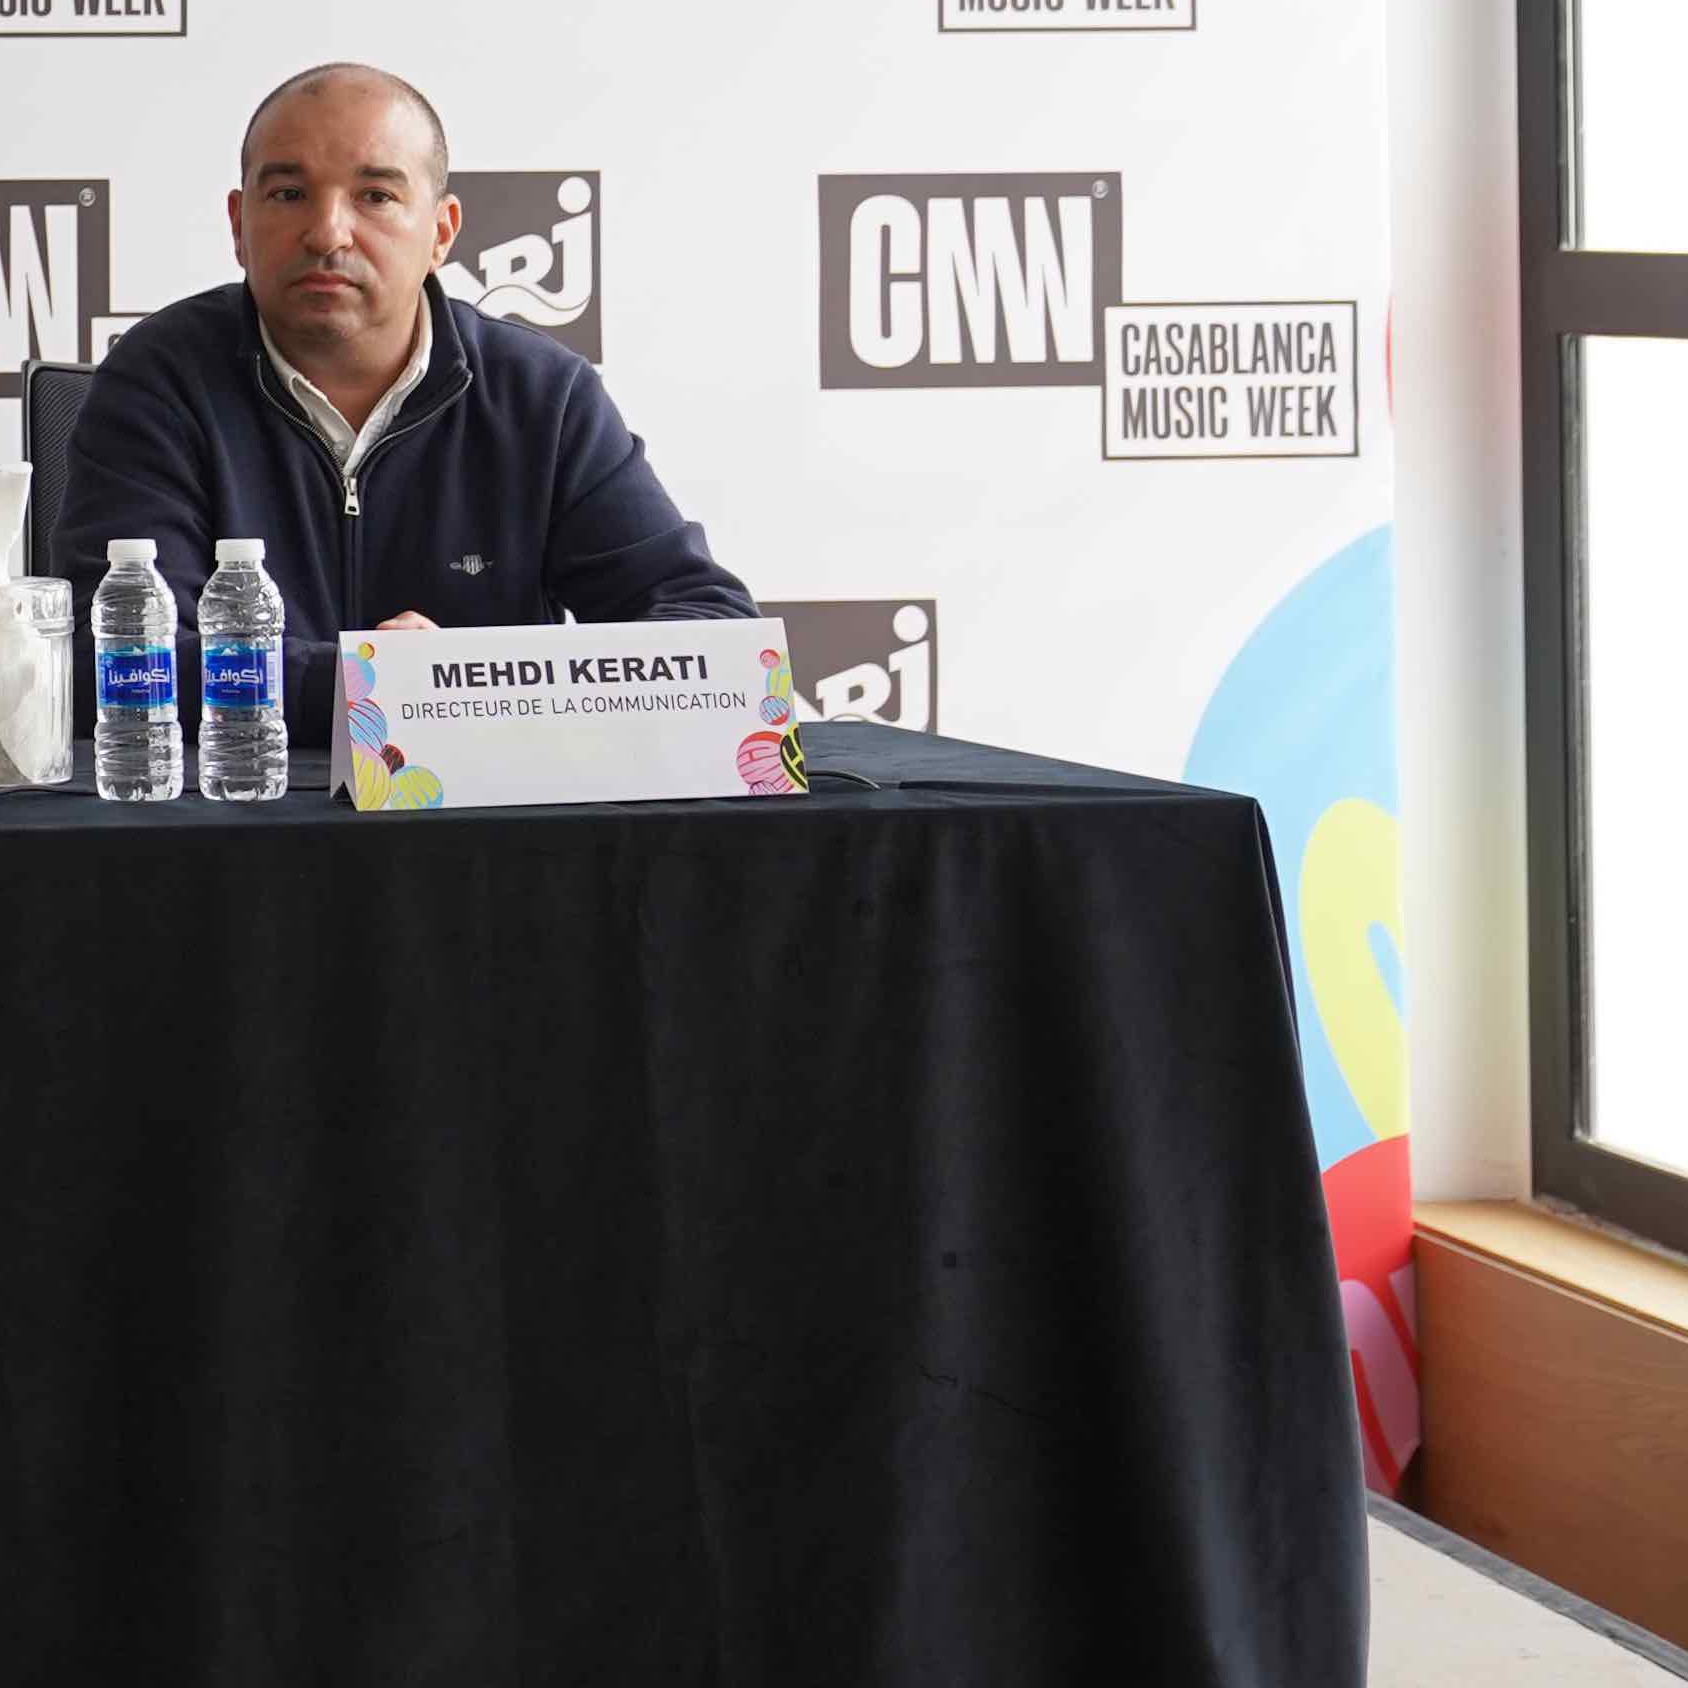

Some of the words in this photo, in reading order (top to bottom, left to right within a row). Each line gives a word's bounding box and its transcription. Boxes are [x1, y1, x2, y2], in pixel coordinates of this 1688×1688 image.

[1122, 322, 1337, 376] CASABLANCA
[1123, 386, 1228, 439] MUSIC
[1247, 386, 1337, 437] WEEK
[432, 659, 555, 688] MEHDI
[569, 655, 708, 684] KERATI
[794, 605, 930, 732] RJ
[402, 699, 513, 720] DIRECTEUR
[518, 698, 543, 716] DE
[552, 698, 576, 715] LA
[581, 692, 747, 714] COMMUNICATION
